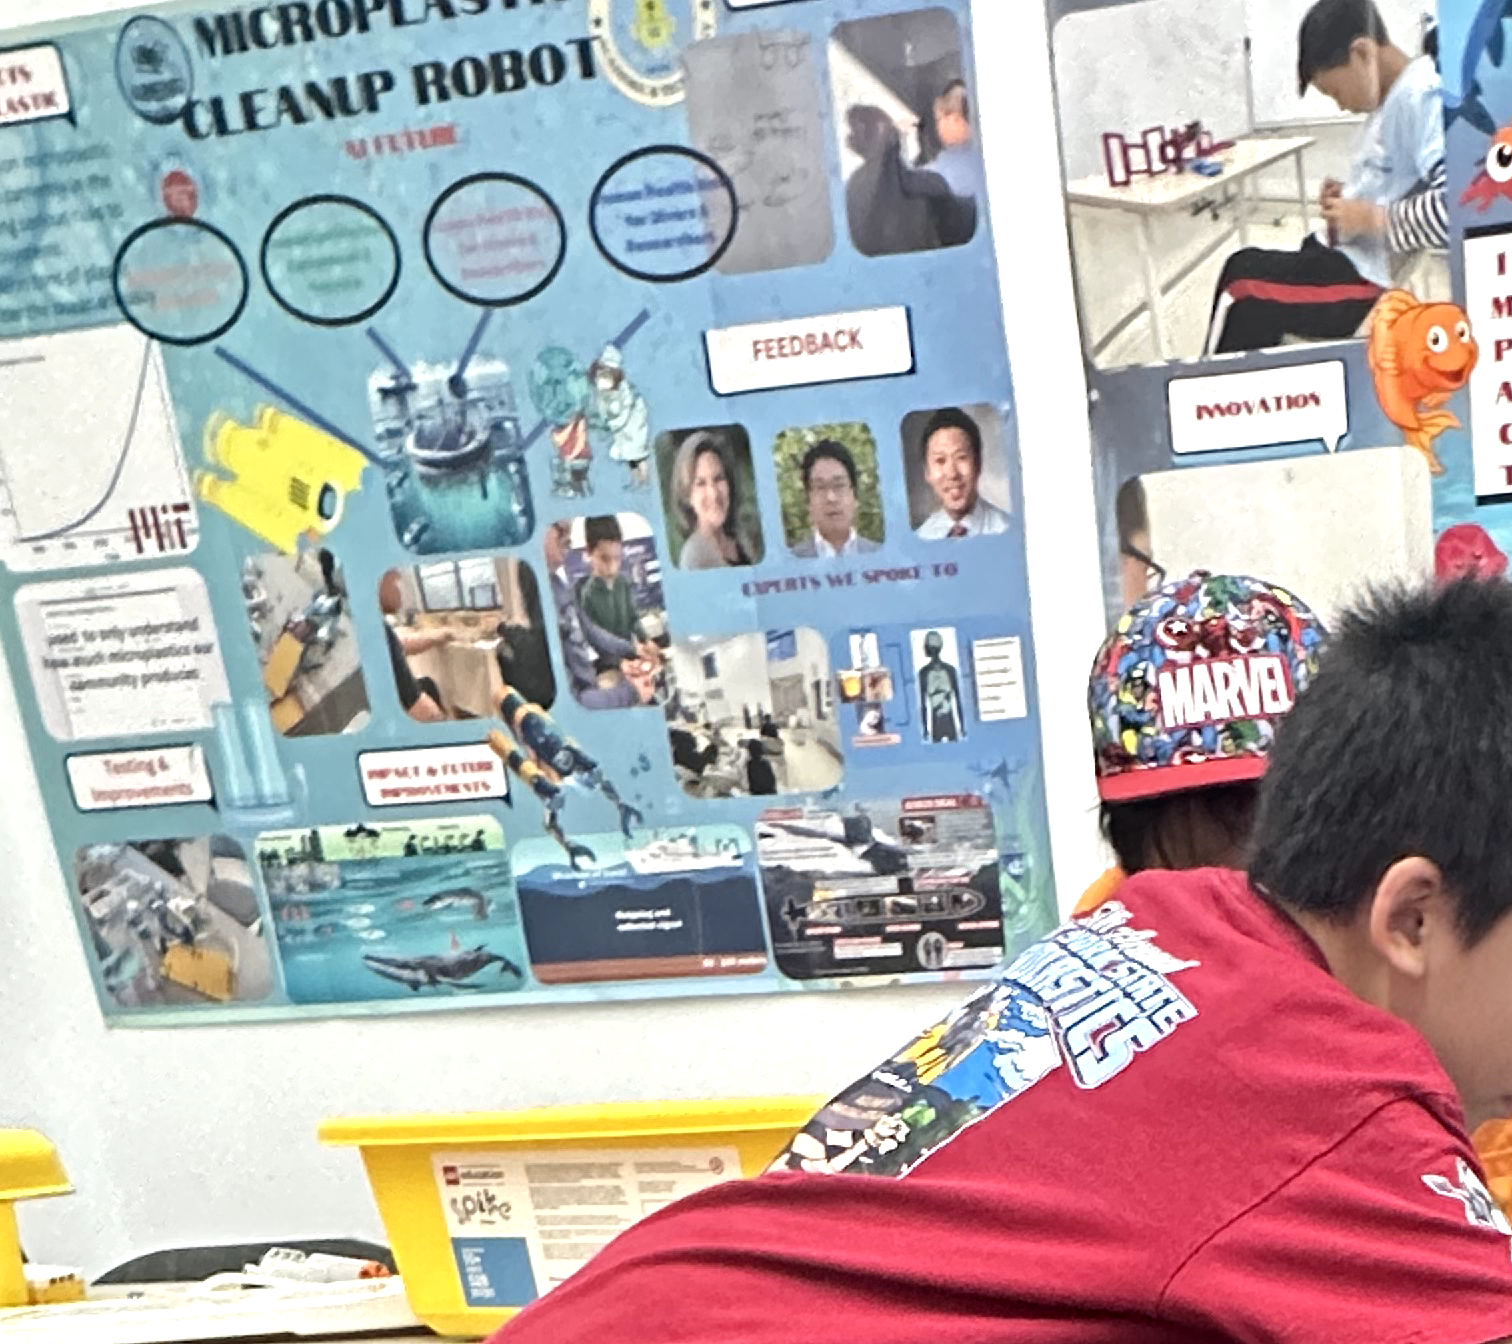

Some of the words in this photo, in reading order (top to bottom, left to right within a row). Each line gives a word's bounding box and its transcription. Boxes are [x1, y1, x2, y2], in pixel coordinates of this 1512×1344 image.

[181, 70, 396, 140] CLEANUP
[411, 35, 602, 105] ROBOT
[751, 327, 865, 362] FEEDBACK
[1195, 391, 1322, 421] INNOVATION
[741, 576, 822, 597] EXPERTS
[825, 572, 855, 588] WE
[861, 565, 921, 585] SPOKE
[931, 562, 959, 578] TO
[1158, 655, 1294, 729] MARVEL
[1101, 962, 1200, 1034] STATE
